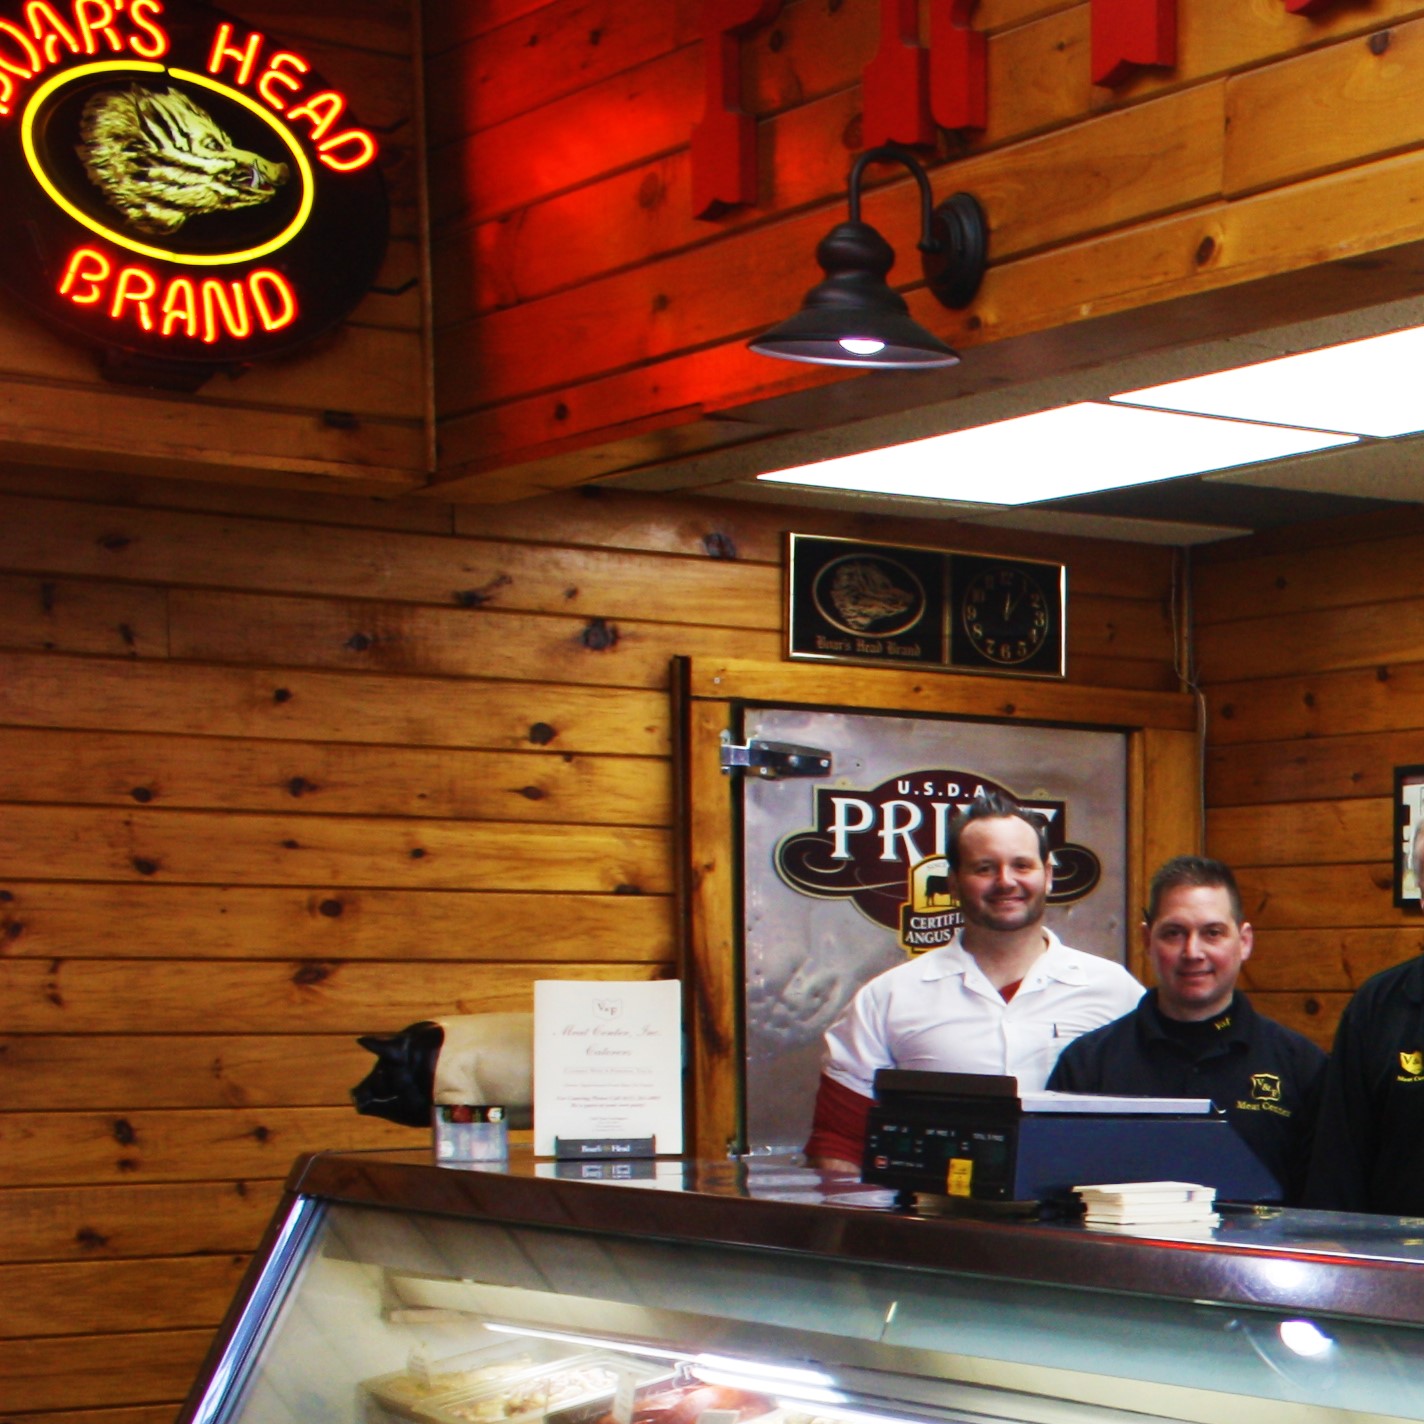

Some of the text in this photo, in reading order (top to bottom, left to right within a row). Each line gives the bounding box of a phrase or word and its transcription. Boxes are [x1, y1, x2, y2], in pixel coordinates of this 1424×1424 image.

[0, 0, 380, 172] OAR'S HEAD
[59, 247, 299, 344] BRAND
[905, 930, 951, 944] ANGUS
[909, 914, 966, 930] CERTIFI
